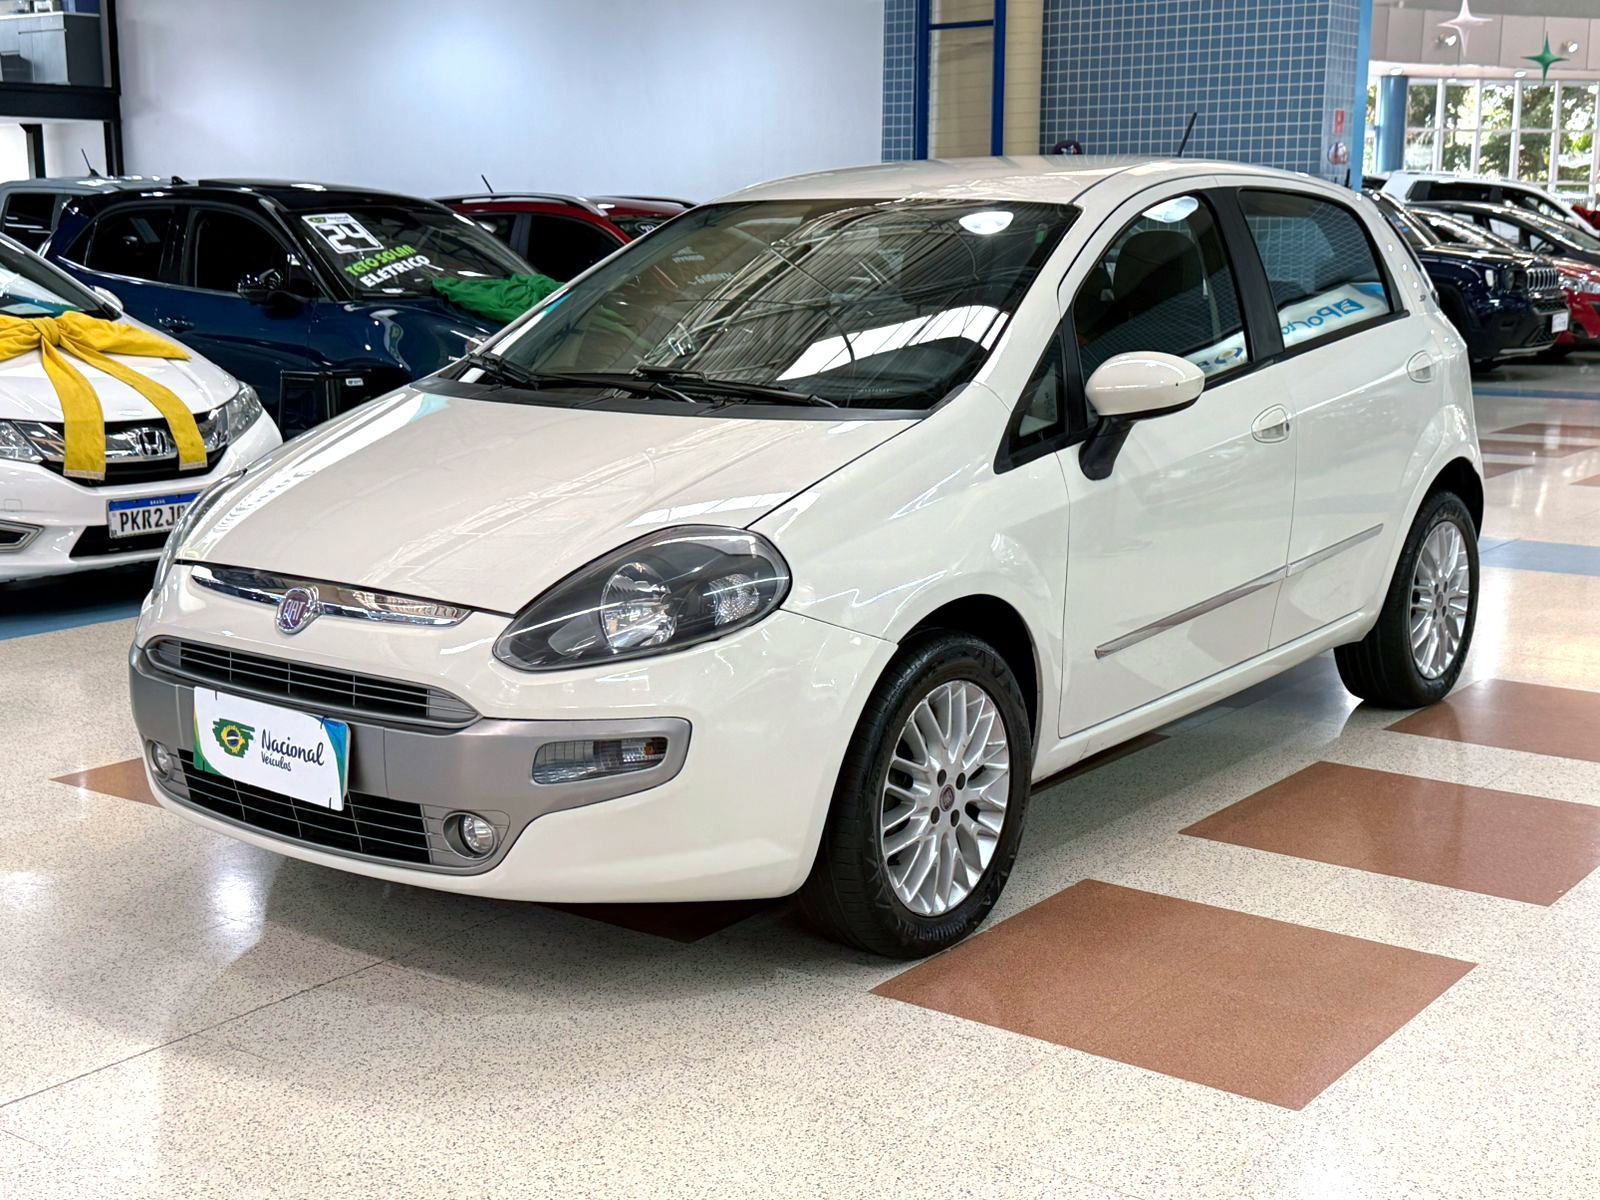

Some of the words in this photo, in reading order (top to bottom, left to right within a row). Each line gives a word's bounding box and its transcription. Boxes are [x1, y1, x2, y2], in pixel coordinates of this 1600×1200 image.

[317, 223, 379, 251] 24
[345, 257, 376, 276] TETO
[375, 244, 417, 265] SOLAR
[360, 255, 431, 288] ELÉTRICO
[261, 729, 325, 766] Nacional
[261, 751, 292, 772] Veículos
